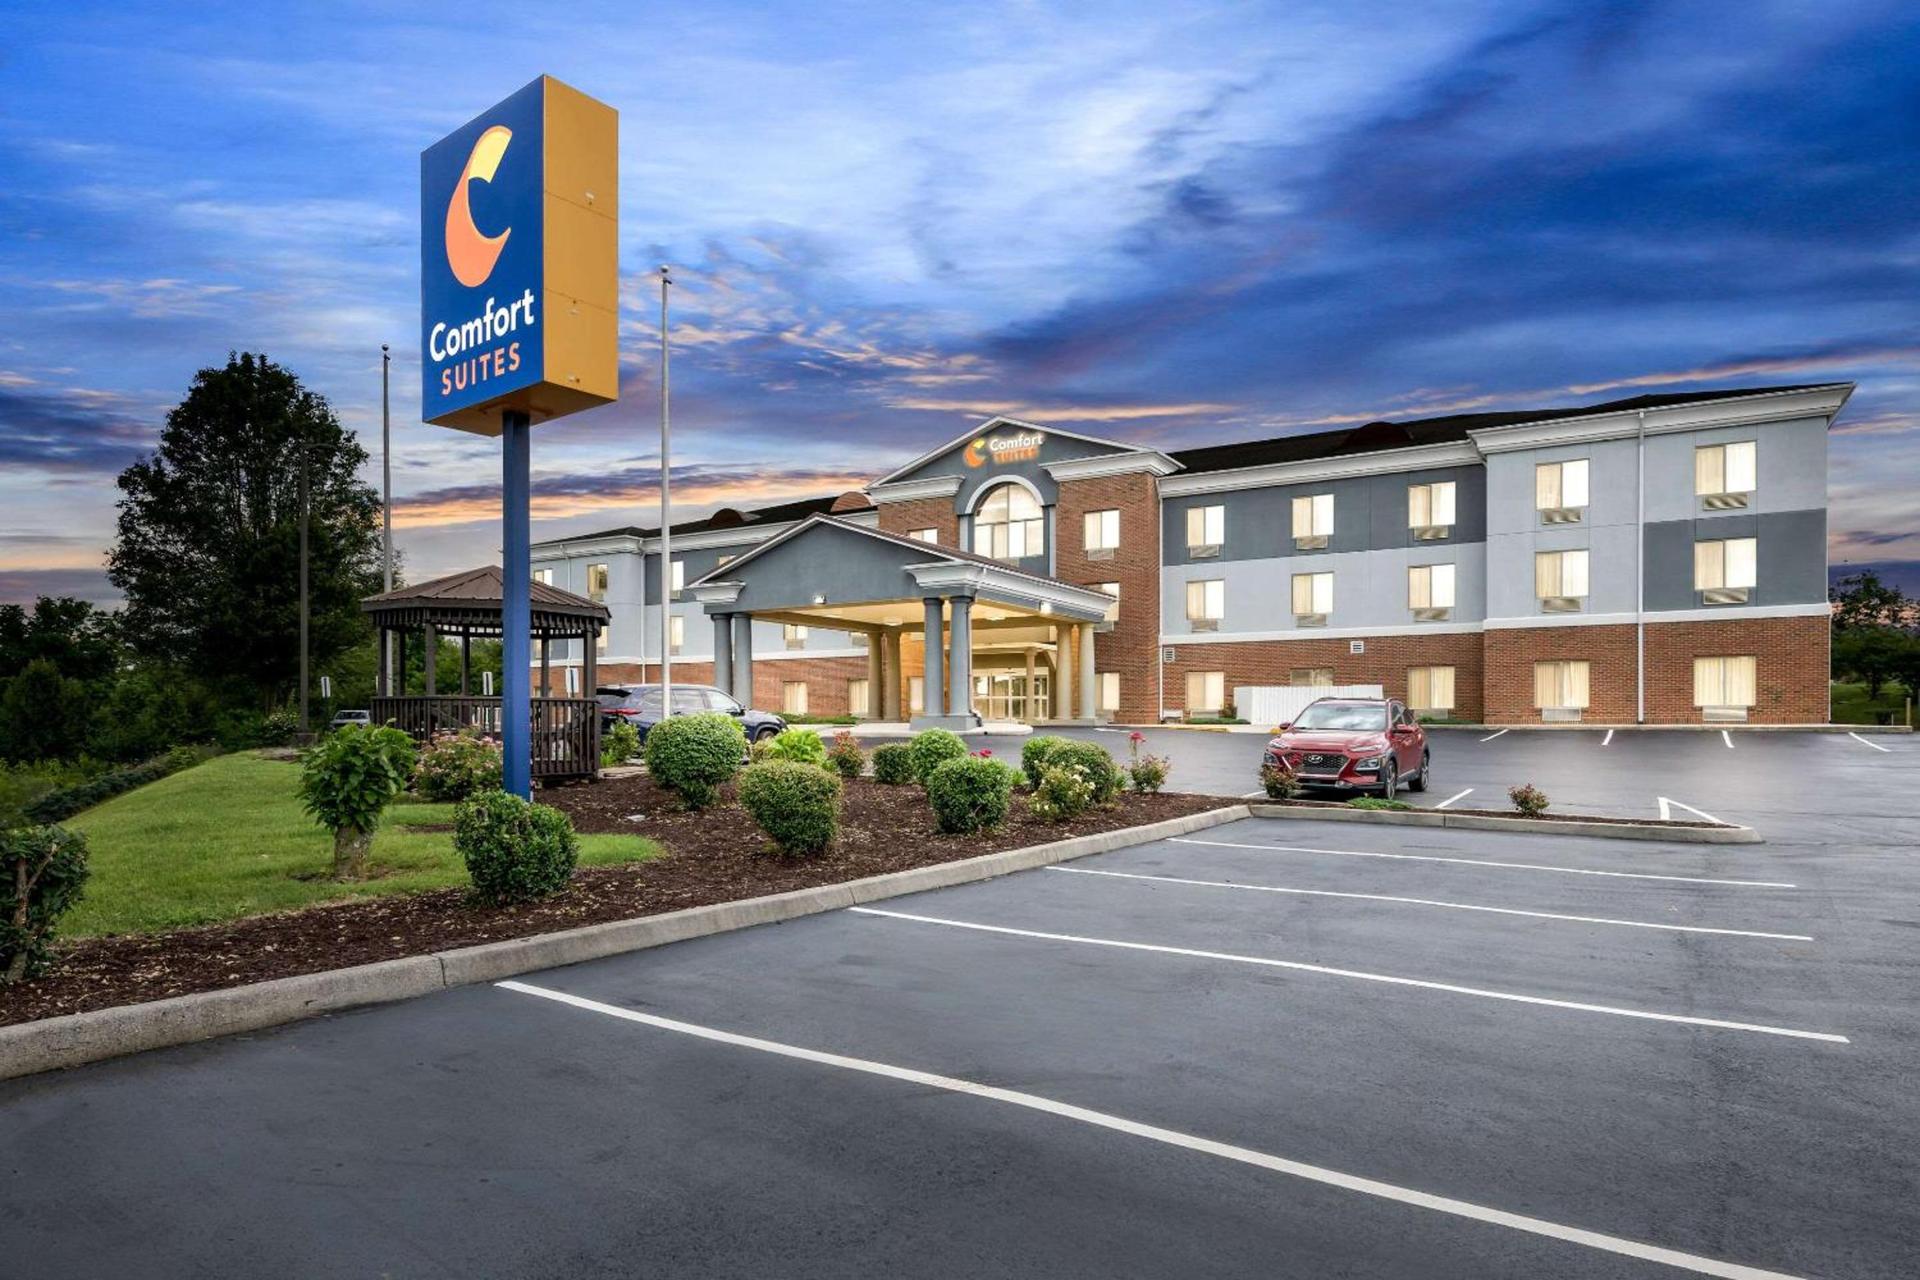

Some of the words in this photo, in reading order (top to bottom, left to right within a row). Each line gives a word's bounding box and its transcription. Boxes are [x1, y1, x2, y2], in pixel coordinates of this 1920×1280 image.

[430, 289, 534, 361] Comfort
[442, 343, 520, 395] SUITES
[990, 433, 1043, 451] Comfort
